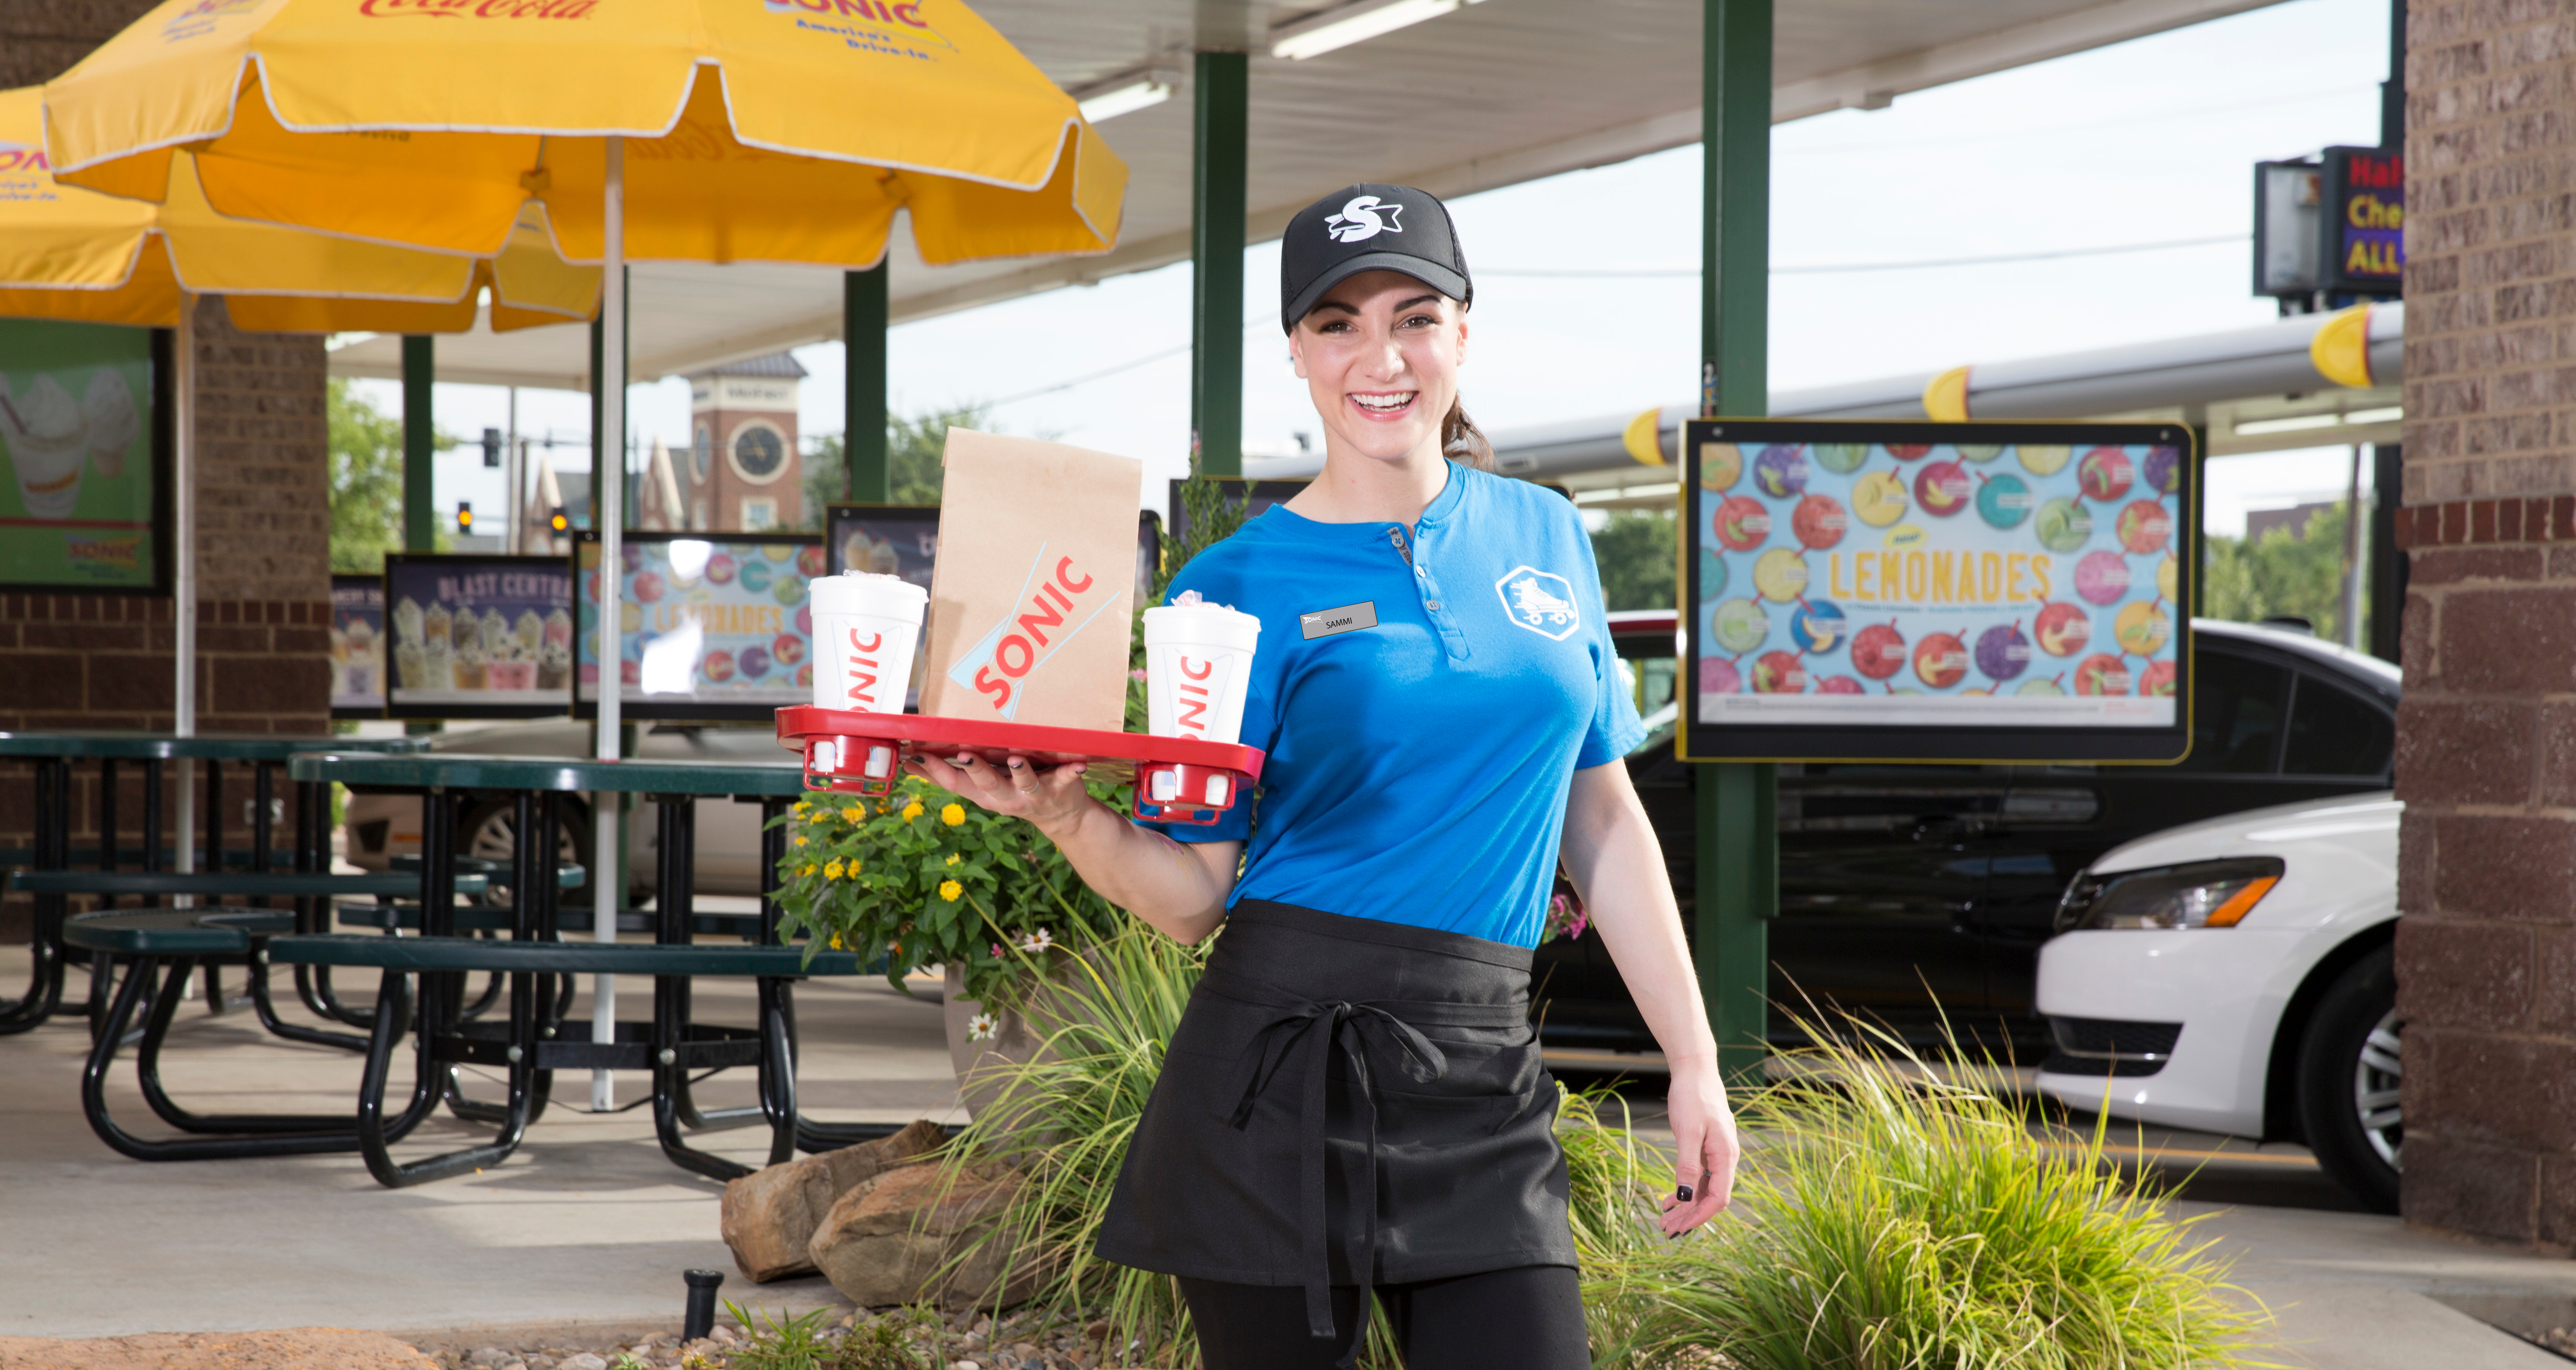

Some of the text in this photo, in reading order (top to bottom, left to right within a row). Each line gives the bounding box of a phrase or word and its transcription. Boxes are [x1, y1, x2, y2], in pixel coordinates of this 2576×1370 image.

[766, 0, 927, 28] ONIC
[797, 18, 890, 42] America's
[2346, 239, 2400, 274] ALL
[437, 573, 499, 601] BLAST
[1831, 551, 2050, 601] LEMONADES
[975, 555, 1093, 710] SONIC
[1304, 615, 1322, 625] SONIC
[1326, 617, 1352, 629] SAMMI
[848, 628, 881, 712] NIC
[1178, 655, 1212, 741] NIC
